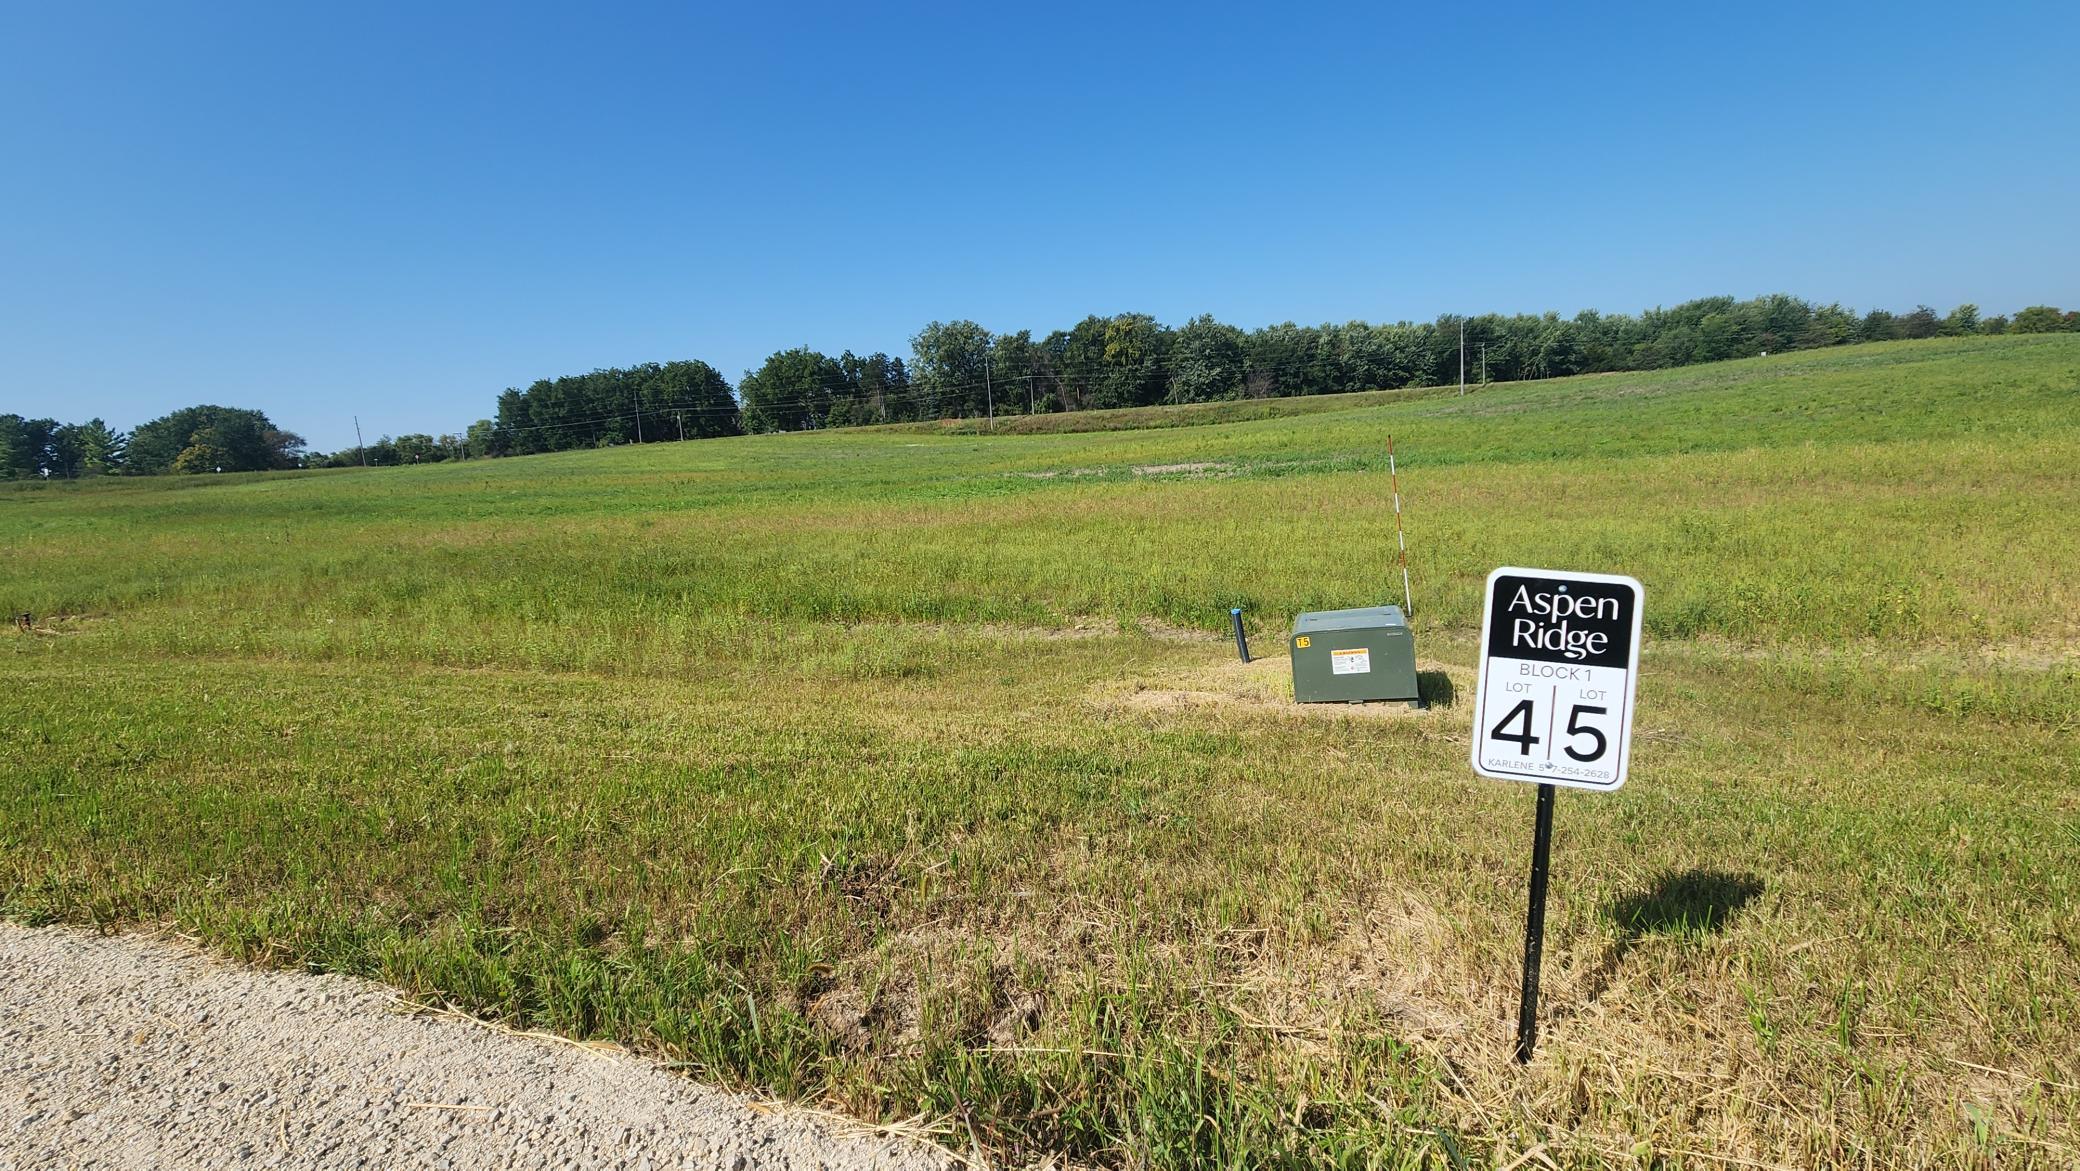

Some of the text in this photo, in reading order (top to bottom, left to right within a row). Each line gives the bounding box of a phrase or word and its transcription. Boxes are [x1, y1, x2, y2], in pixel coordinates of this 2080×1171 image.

[1508, 584, 1619, 623] Aspen
[1512, 618, 1608, 660] Ridge
[1505, 681, 1532, 694] LOT
[1520, 663, 1592, 682] BLOCK 1
[1579, 688, 1607, 701] LOT
[1490, 699, 1540, 756] 4
[1563, 704, 1607, 763] 5
[1488, 758, 1610, 779] KARLENE 57-254-2628
